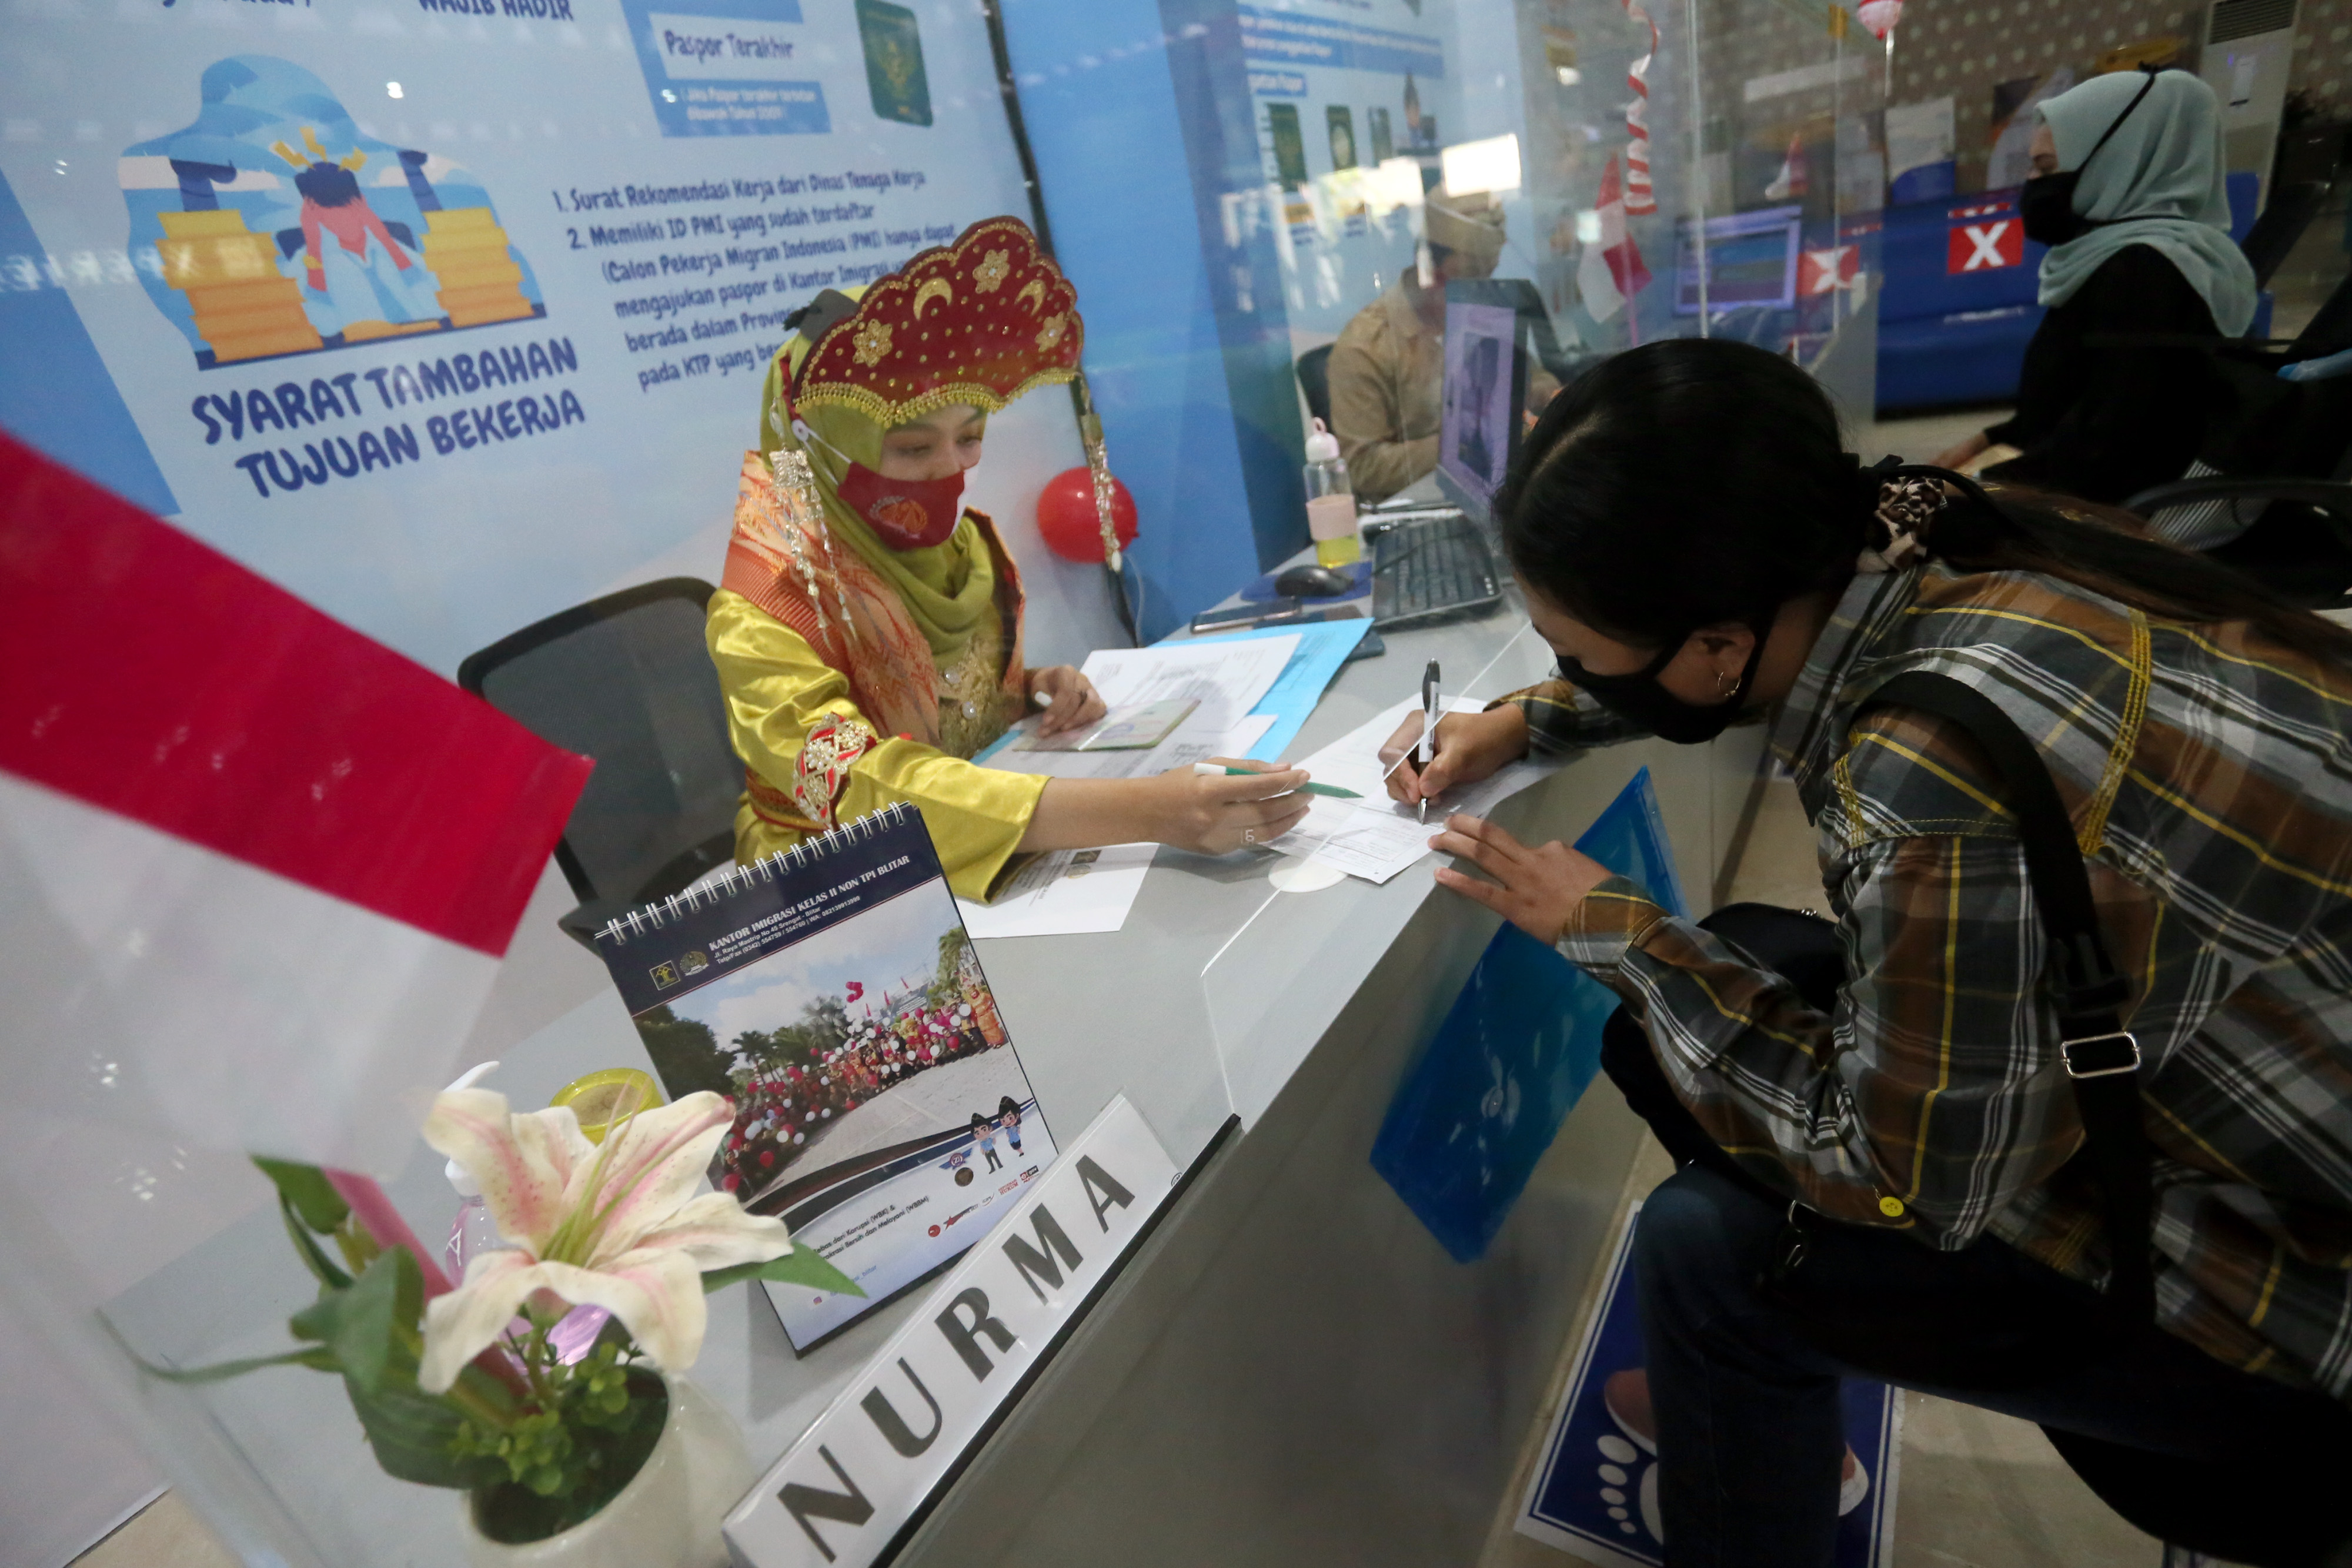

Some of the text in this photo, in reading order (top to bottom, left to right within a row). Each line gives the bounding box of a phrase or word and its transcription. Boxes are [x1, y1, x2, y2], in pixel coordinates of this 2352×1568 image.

[502, 0, 574, 21] HADIR
[663, 29, 794, 63] Paspor Terakhir
[570, 187, 625, 213] Surat
[624, 180, 730, 207] Rekomendasi
[731, 176, 774, 202] Kerja
[777, 175, 807, 195] dari
[808, 173, 845, 193] Dinas
[846, 170, 891, 194] Tenaga
[891, 169, 926, 190] Kerja
[589, 222, 666, 247] Memiliki
[666, 218, 687, 239] ID
[691, 214, 724, 236] PMI
[727, 212, 766, 239] yang
[767, 207, 809, 228] sudah
[811, 202, 874, 224] terdaftar
[602, 260, 657, 286] (Calon
[659, 254, 723, 277] Pekerja
[725, 247, 779, 271] Migran
[780, 239, 847, 260] Indonesia
[614, 289, 715, 319] mengajukan
[719, 280, 768, 309] paspor
[772, 272, 786, 293] di
[787, 270, 836, 290] Kantor
[624, 307, 791, 354] berada dalam Provin
[192, 337, 577, 445] SYARAT TAMBAHAN
[637, 361, 681, 394] pada
[682, 354, 711, 376] KTP
[715, 349, 755, 377] yang
[235, 389, 584, 497] TUJUAN BEKERJA
[709, 927, 750, 951] KANTOR
[751, 906, 796, 932] IMIGRASI
[797, 892, 828, 911] KELAS
[838, 878, 859, 892] NON
[859, 870, 877, 882] TPI
[877, 855, 910, 875] BLITAR
[716, 950, 742, 964] Telp/Fax
[742, 942, 761, 954] (0342)
[722, 944, 738, 954] Raya
[739, 934, 761, 947] Mastrip
[779, 915, 801, 930] Srengat
[805, 907, 821, 917] Blitar
[833, 1234, 846, 1244] dari
[846, 1219, 870, 1236] Korupsi
[870, 1208, 888, 1223] (WBK)
[845, 1234, 864, 1248] Bersih
[865, 1227, 877, 1236] dan
[878, 1210, 905, 1229] Melayani
